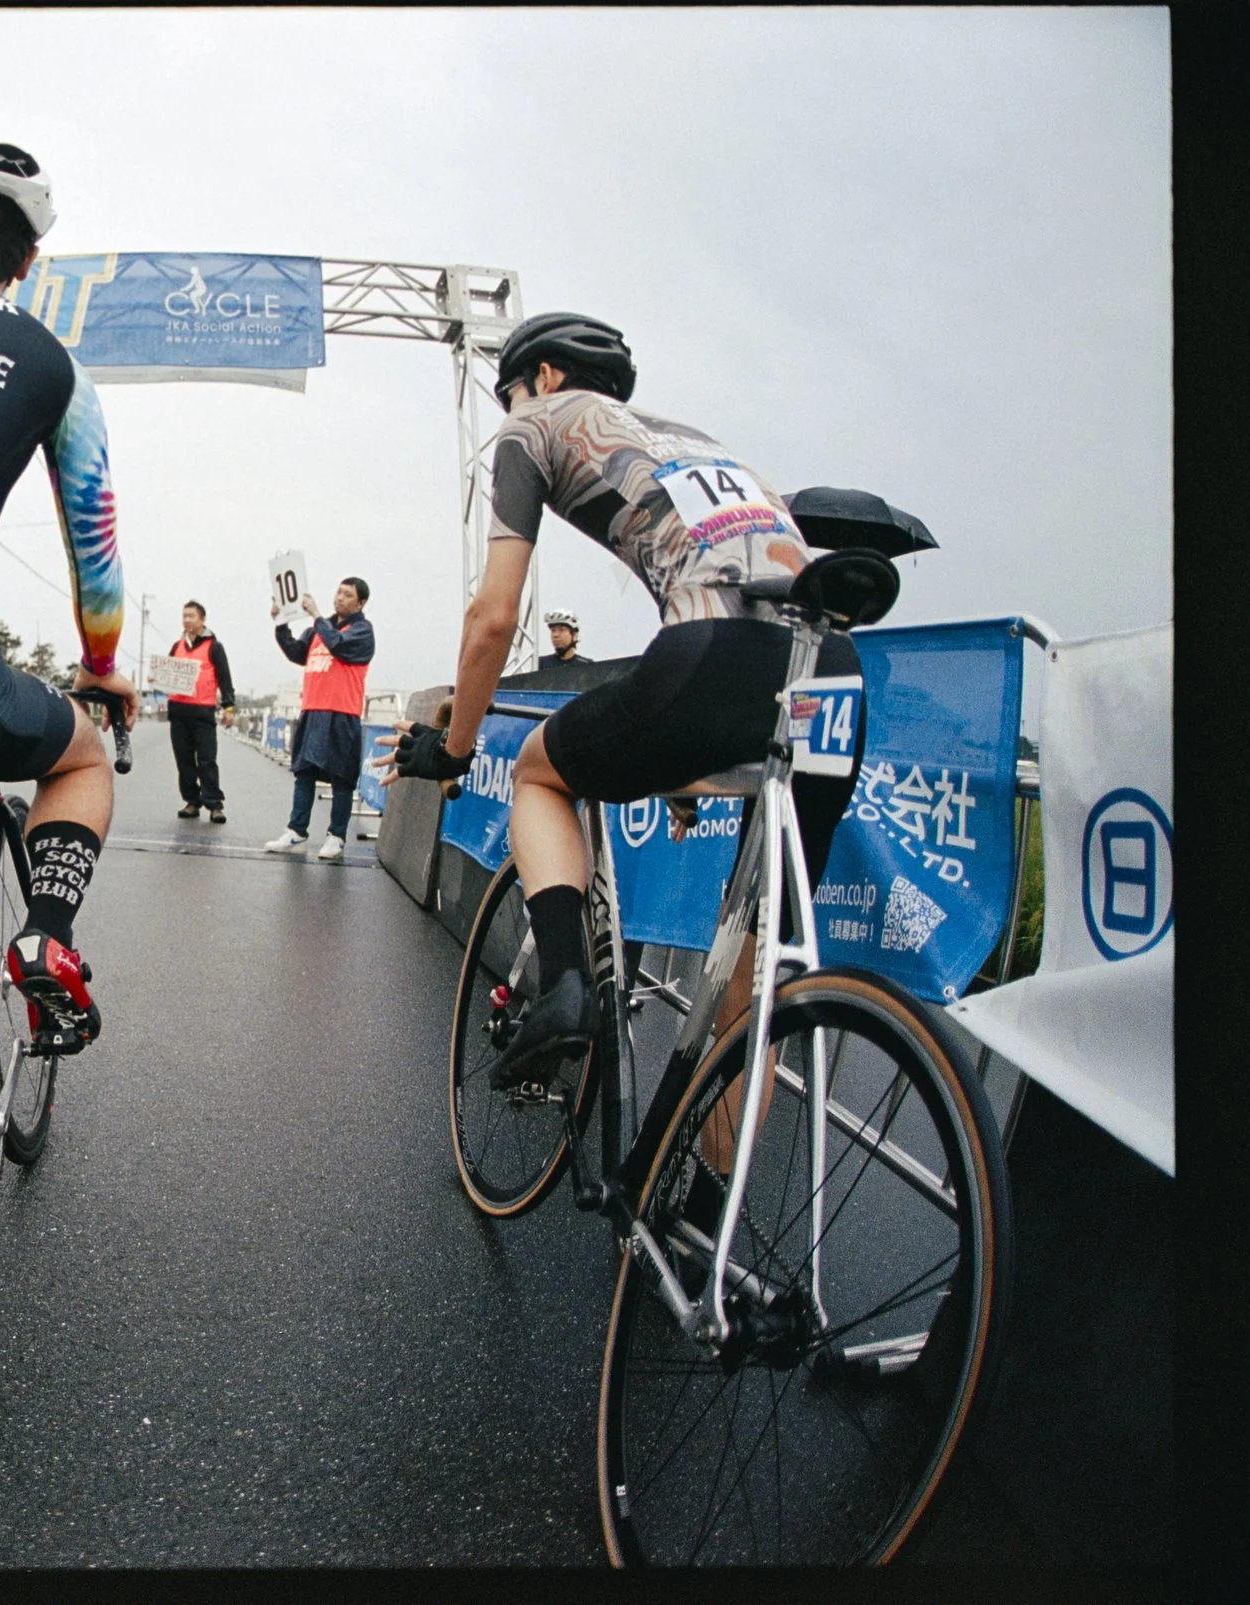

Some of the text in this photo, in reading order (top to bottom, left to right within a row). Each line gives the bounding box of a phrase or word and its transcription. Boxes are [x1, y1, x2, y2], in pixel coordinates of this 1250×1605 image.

[164, 290, 281, 319] CYCLE
[165, 319, 282, 334] JKA Social Action
[686, 469, 748, 507] 14
[275, 570, 299, 606] 10
[821, 695, 853, 752] 14
[35, 837, 97, 868] BLAC
[44, 850, 89, 873] SOX
[32, 880, 78, 905] CLUB
[812, 877, 876, 915] coben.co.jp
